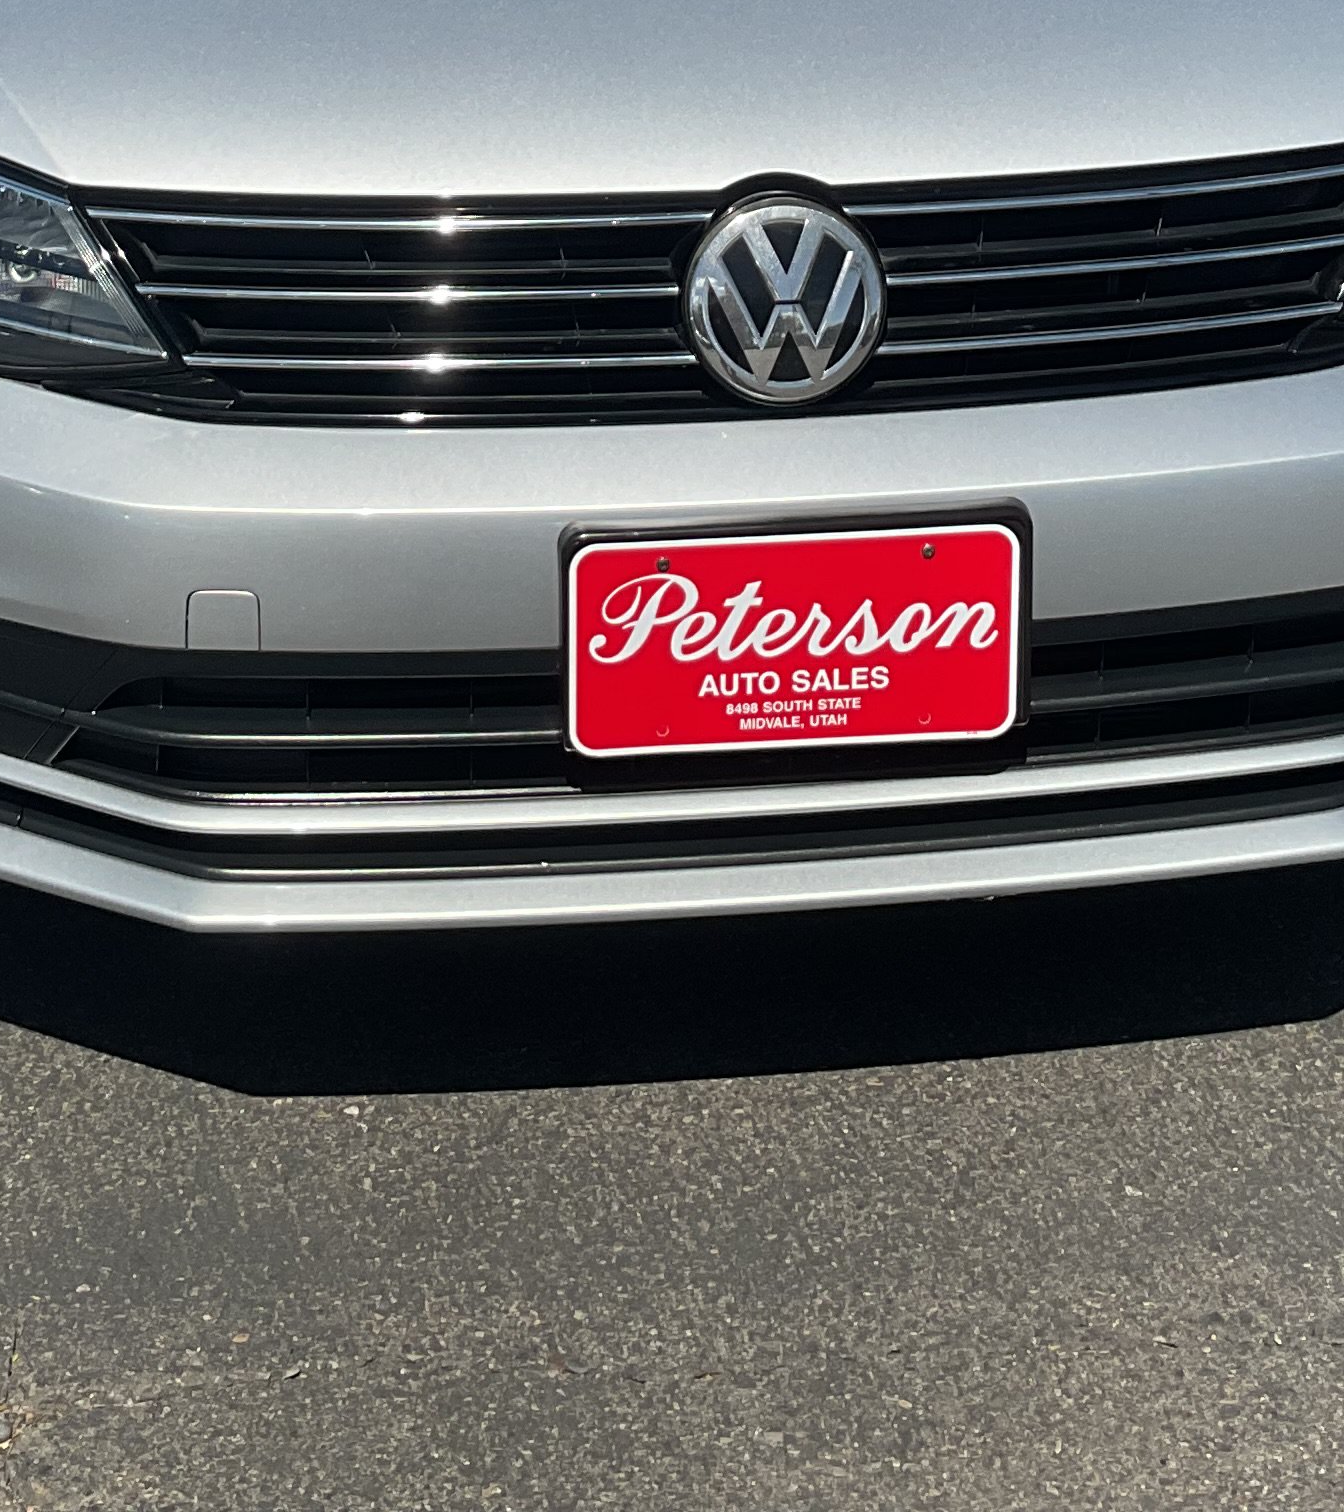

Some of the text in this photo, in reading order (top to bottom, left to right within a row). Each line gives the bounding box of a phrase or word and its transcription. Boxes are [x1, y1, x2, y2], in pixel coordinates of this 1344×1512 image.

[588, 573, 1000, 664] Peterson
[698, 665, 890, 698] AUTO SALES
[725, 696, 862, 715] 8498 SOUTH STATE
[739, 713, 848, 731] MIDVALE, UTAH
